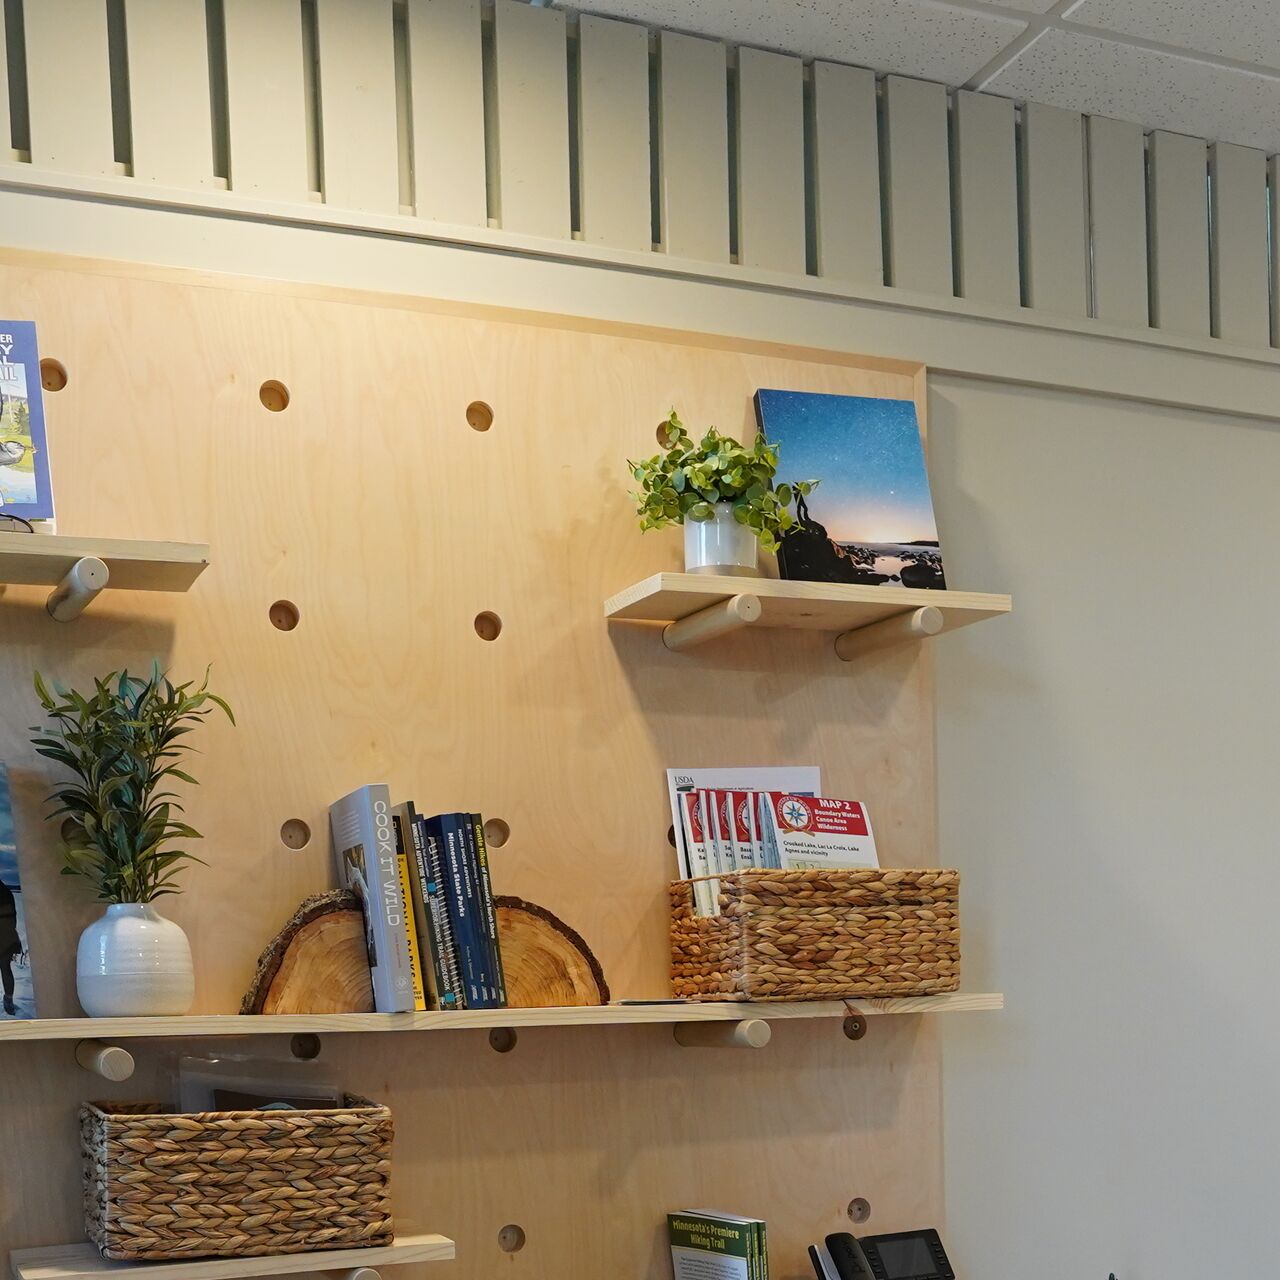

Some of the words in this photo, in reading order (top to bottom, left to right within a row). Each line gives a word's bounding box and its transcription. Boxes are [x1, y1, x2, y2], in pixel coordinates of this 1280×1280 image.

[674, 776, 694, 784] USDA
[814, 808, 841, 818] Boundary
[840, 811, 861, 819] Waters
[818, 798, 842, 809] MAP
[844, 802, 852, 810] 2
[374, 800, 391, 854] COOK
[412, 823, 420, 850] MINNESOTA
[476, 824, 484, 846] Gentle
[817, 823, 848, 832] Wilderness
[448, 832, 458, 872] Minnesota
[783, 840, 804, 848] Crooked
[381, 857, 395, 882] IT
[416, 850, 426, 878] ADVENTURE
[481, 866, 488, 874] of
[420, 878, 430, 904] WEEKENDS
[454, 873, 462, 895] State
[464, 866, 472, 898] ADVENTURES
[482, 874, 492, 906] Minnesota's
[384, 884, 400, 926] WILD
[457, 896, 465, 918] Parks
[432, 922, 443, 942] HIKING
[436, 943, 445, 958] TRAIL
[439, 959, 451, 991] GUIDEBOOK
[673, 1220, 710, 1234] Minnesota's
[710, 1224, 740, 1240] Premiere
[690, 1234, 710, 1249] Hiking
[710, 1237, 726, 1248] Trail
